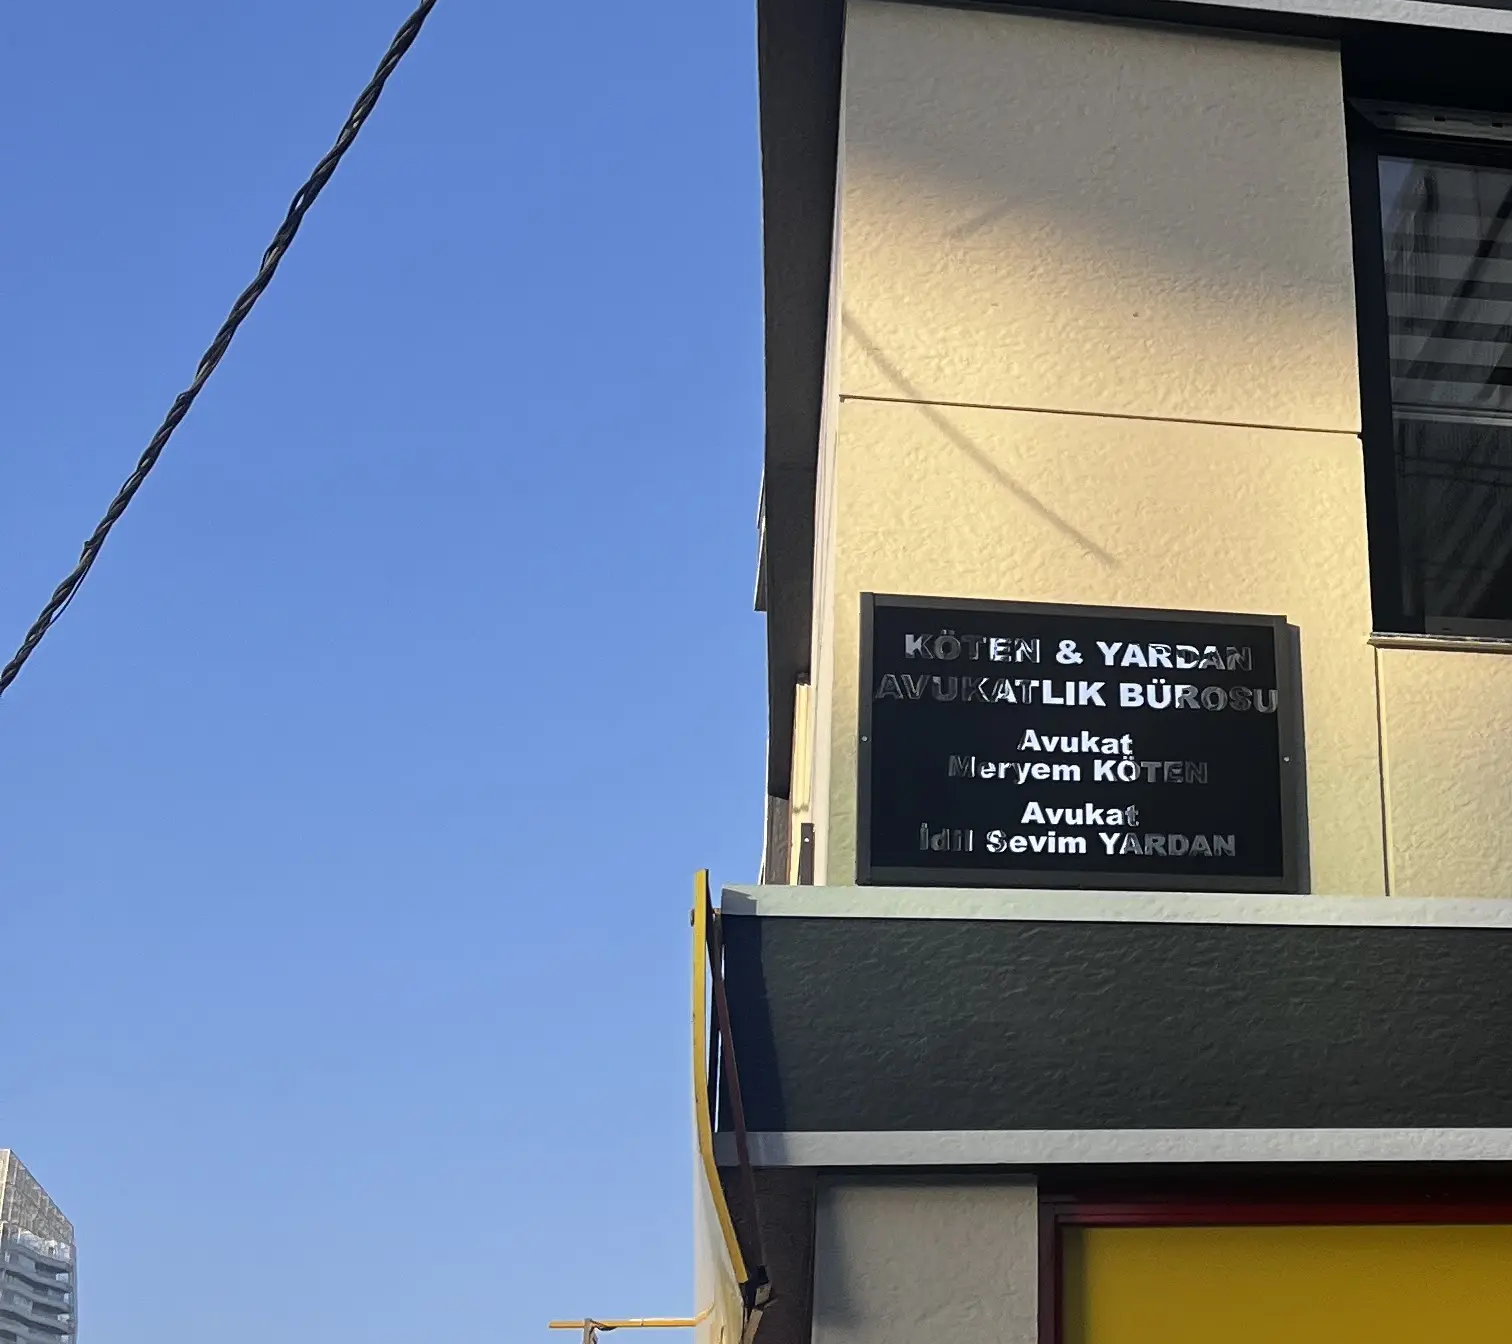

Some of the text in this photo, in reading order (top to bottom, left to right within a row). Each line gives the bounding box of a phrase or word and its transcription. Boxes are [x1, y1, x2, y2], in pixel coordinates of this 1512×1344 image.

[904, 629, 1252, 671] KÖTEN & YARDAN
[875, 673, 1278, 714] AVUKATLIK BÜROSU
[1017, 729, 1133, 755] Avukat
[949, 755, 1208, 785] Meryem KÖTEN
[1020, 801, 1139, 827] Avukat
[986, 829, 1087, 854] Sevim
[1098, 832, 1236, 857] YARDAN
